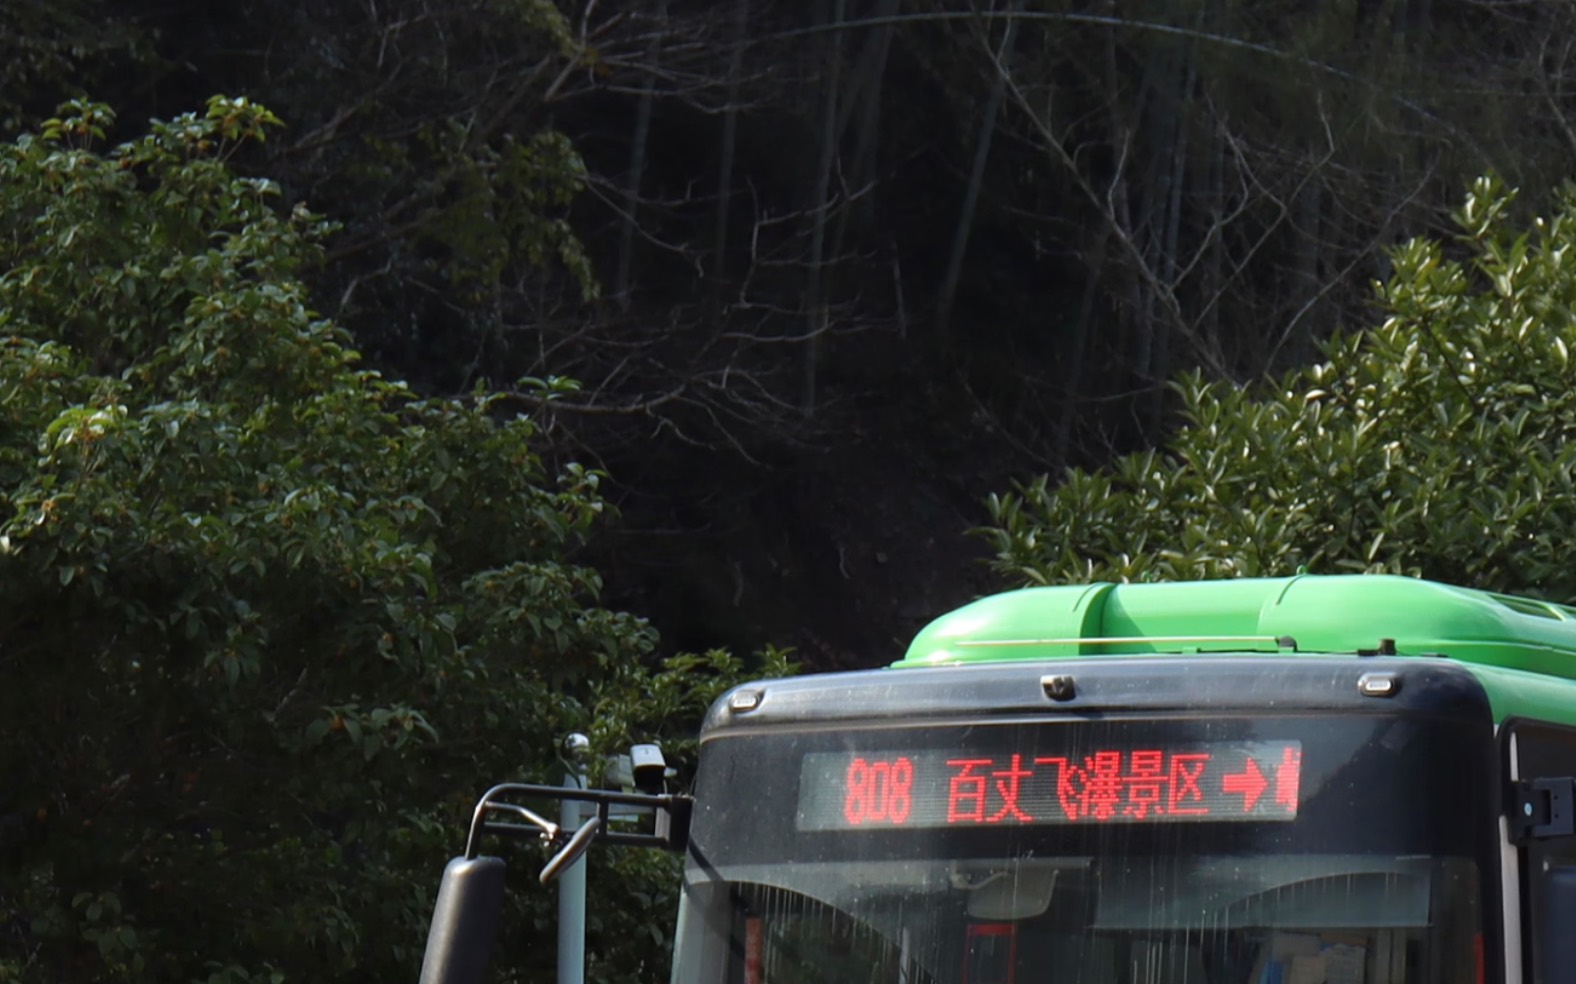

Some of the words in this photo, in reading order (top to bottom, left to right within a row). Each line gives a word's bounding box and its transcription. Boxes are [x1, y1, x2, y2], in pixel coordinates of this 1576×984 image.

[844, 758, 913, 824] 808
[946, 750, 1212, 823] 百丈飞瀑景区
